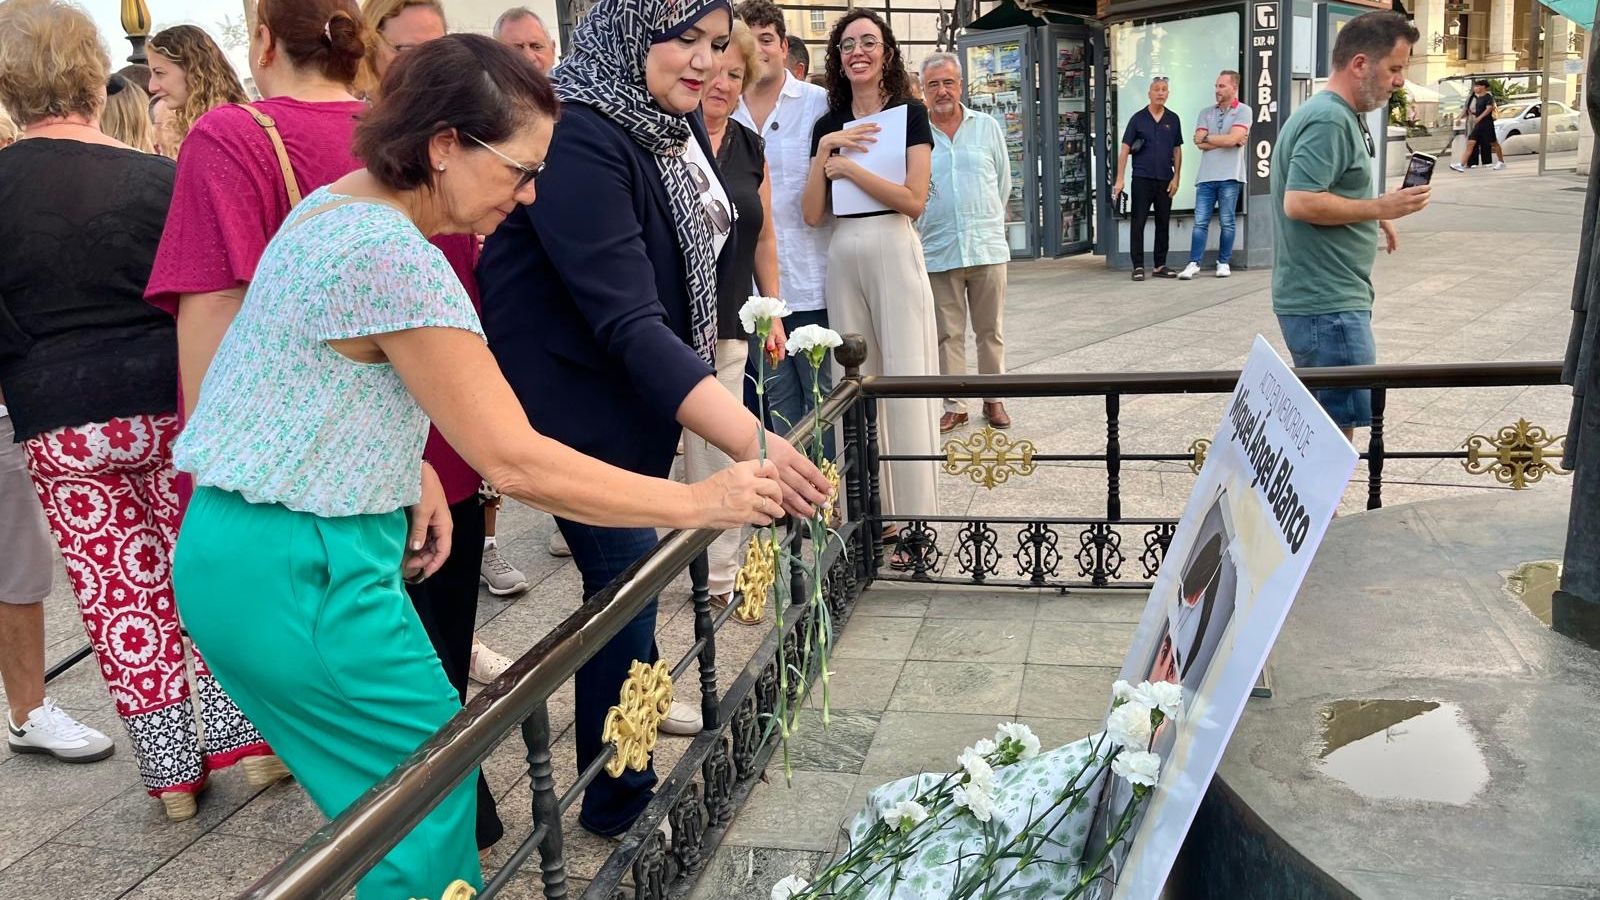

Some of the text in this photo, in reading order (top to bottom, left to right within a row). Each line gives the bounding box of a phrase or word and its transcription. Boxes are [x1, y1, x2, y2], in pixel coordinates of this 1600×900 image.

[1229, 384, 1310, 554] Miguel Ángel Blanco
[1276, 392, 1305, 445] MEMORIA
[1297, 424, 1315, 458] DE
